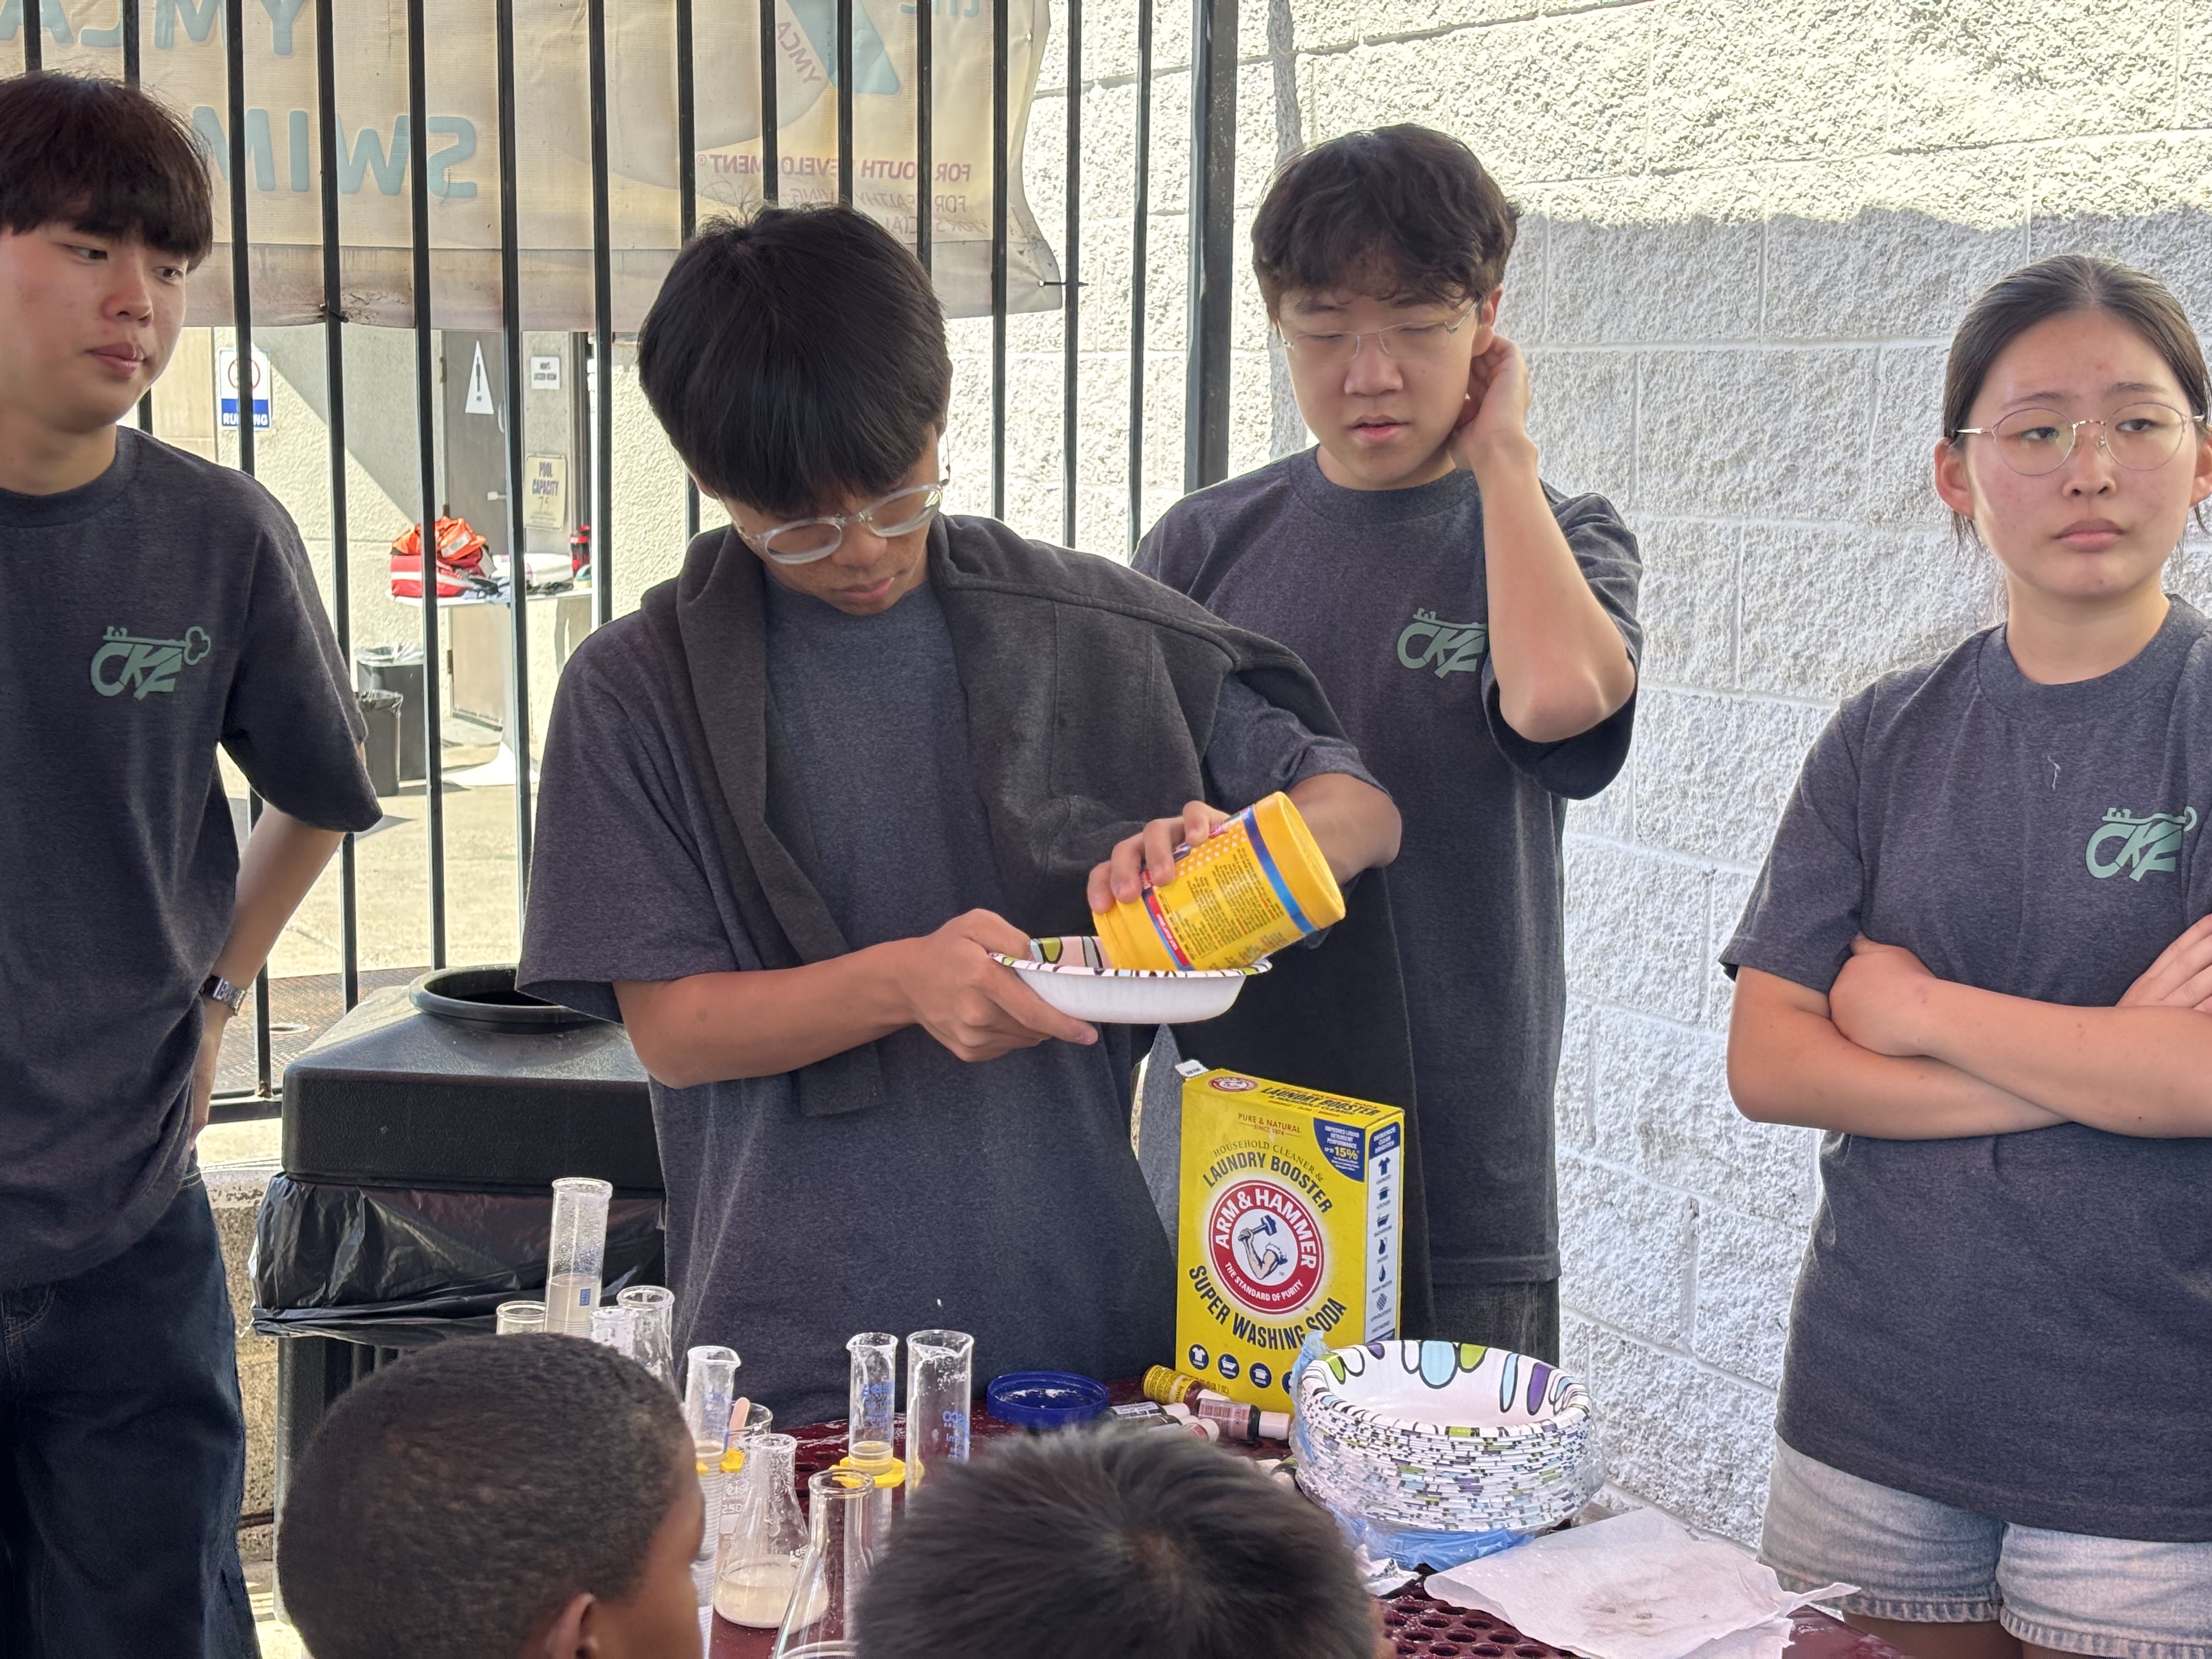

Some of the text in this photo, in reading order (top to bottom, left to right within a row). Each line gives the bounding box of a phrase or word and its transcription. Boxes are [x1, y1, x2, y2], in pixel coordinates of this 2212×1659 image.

[532, 479, 558, 496] CAPACITY
[1261, 1087, 1321, 1103] LAUNDRY
[1318, 1099, 1381, 1116] BOOSTER
[1238, 1113, 1256, 1123] PURE
[1267, 1119, 1301, 1133] NATURAL
[1254, 1124, 1270, 1133] SINCE
[1213, 1140, 1269, 1158] HOUSEHOLD
[1273, 1145, 1315, 1174] CLEANER
[1315, 1173, 1324, 1182] &
[1203, 1152, 1333, 1214] LAUNDRY BOOSTER
[1215, 1188, 1316, 1269] ARM & HAMMER
[1224, 1262, 1304, 1302] THE STANDARD OF PURITY
[1189, 1265, 1347, 1351] SUPER WASHING SODA
